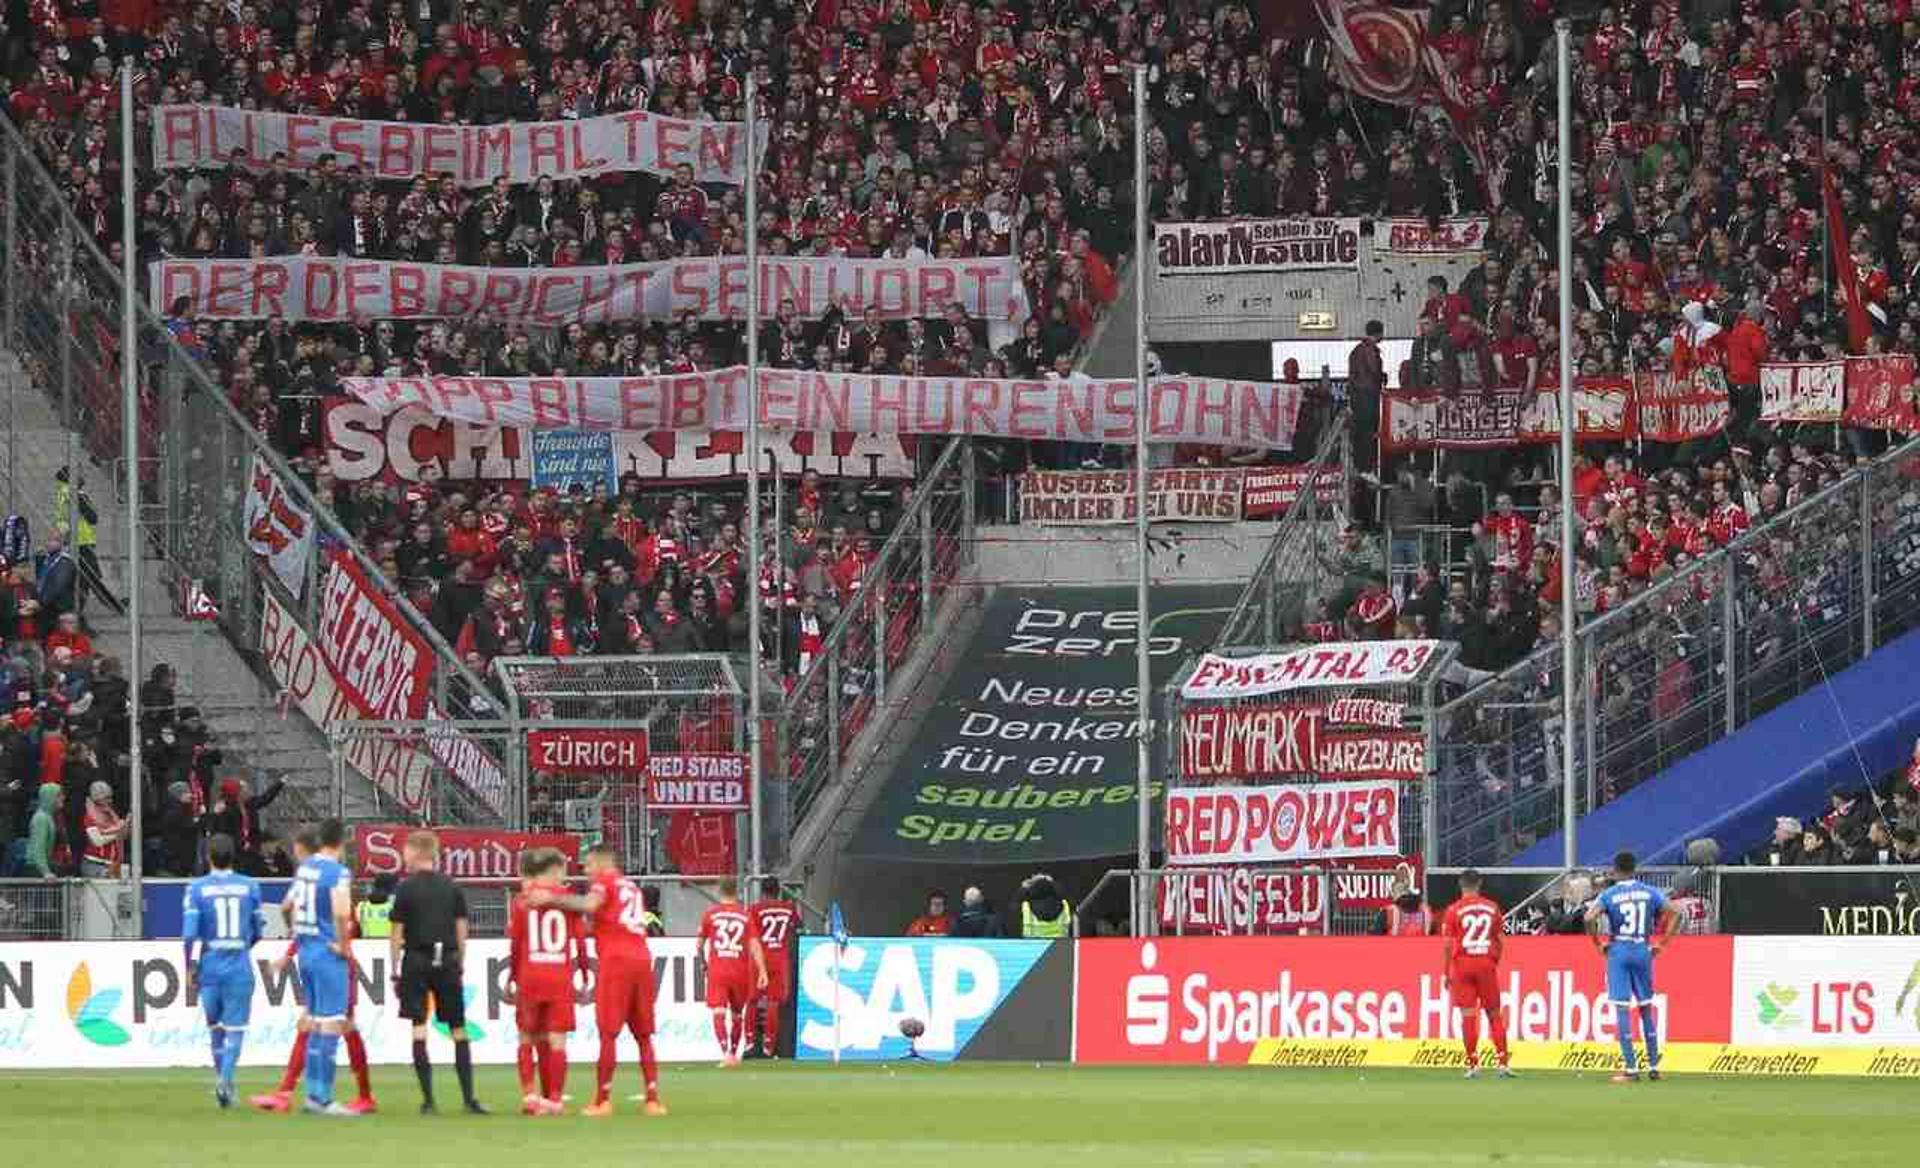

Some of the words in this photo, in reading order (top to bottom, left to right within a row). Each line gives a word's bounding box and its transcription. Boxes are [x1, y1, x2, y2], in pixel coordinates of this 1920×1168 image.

[165, 107, 363, 171] ALLES
[380, 124, 511, 181] BEIM
[528, 110, 737, 175] ALTEN
[163, 262, 290, 317] DER
[304, 262, 428, 319] DFB
[437, 267, 655, 321] BRICHT
[671, 261, 814, 316] SEIN
[528, 366, 746, 430] BLEIBT
[760, 371, 850, 431] EIN
[1023, 498, 1115, 521] IMMER
[1177, 494, 1236, 518] UNS
[1017, 608, 1140, 632] pre
[1005, 634, 1182, 657] zero
[980, 679, 1142, 707] Neues
[959, 712, 1156, 740] Denken
[1180, 709, 1321, 774] NEUMARKT
[541, 735, 635, 767] ZÜRICH
[651, 756, 686, 777] RED
[687, 756, 743, 777] STARS
[938, 746, 1015, 774] für
[1028, 750, 1105, 775] ein
[1320, 741, 1424, 772] HARZBURG
[654, 781, 743, 803] UNITED
[916, 781, 1164, 810] sauberes
[896, 814, 1042, 845] Spiel.
[1169, 796, 1240, 856] RED
[1243, 788, 1397, 852] POWER
[213, 896, 241, 939] 11
[527, 909, 568, 951] 10
[762, 915, 789, 942] 27
[1462, 914, 1491, 947] 22
[1618, 902, 1648, 939] 31
[713, 919, 745, 951] 32
[801, 942, 1000, 1052] SAP
[1811, 981, 1875, 1034] LTS
[1181, 970, 1406, 1061] Sparkasse
[1271, 1040, 1368, 1067] interwetten
[1708, 1046, 1820, 1073] interwetten
[1865, 1046, 1920, 1074] inter
